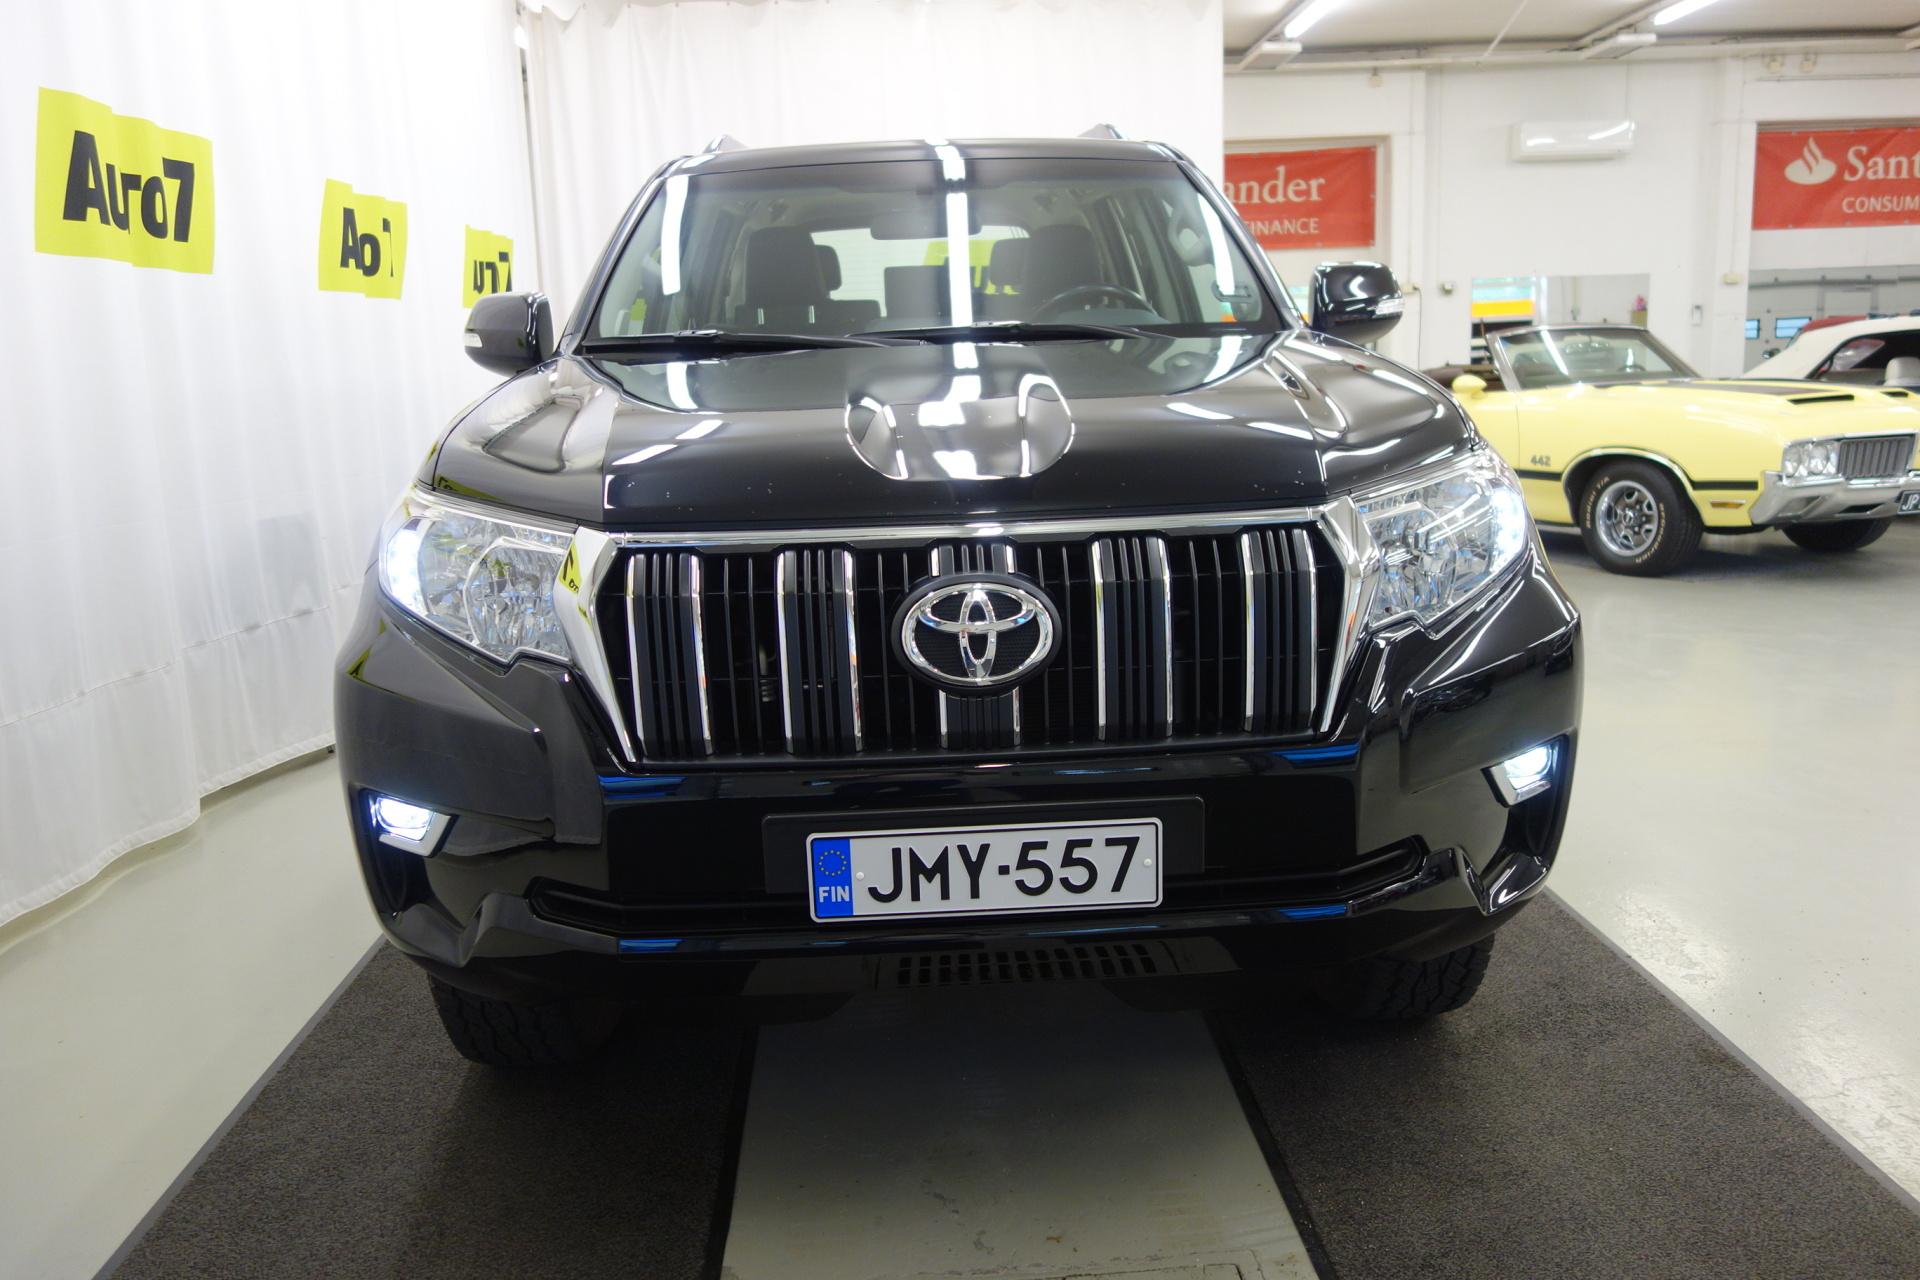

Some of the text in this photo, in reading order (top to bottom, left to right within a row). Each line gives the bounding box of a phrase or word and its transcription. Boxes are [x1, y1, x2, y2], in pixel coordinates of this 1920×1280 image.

[1844, 145, 1920, 181] Sant
[1842, 195, 1920, 213] CONSUM
[1530, 454, 1551, 468] 442
[867, 836, 1141, 903] JMY-557
[818, 886, 850, 903] FIN
